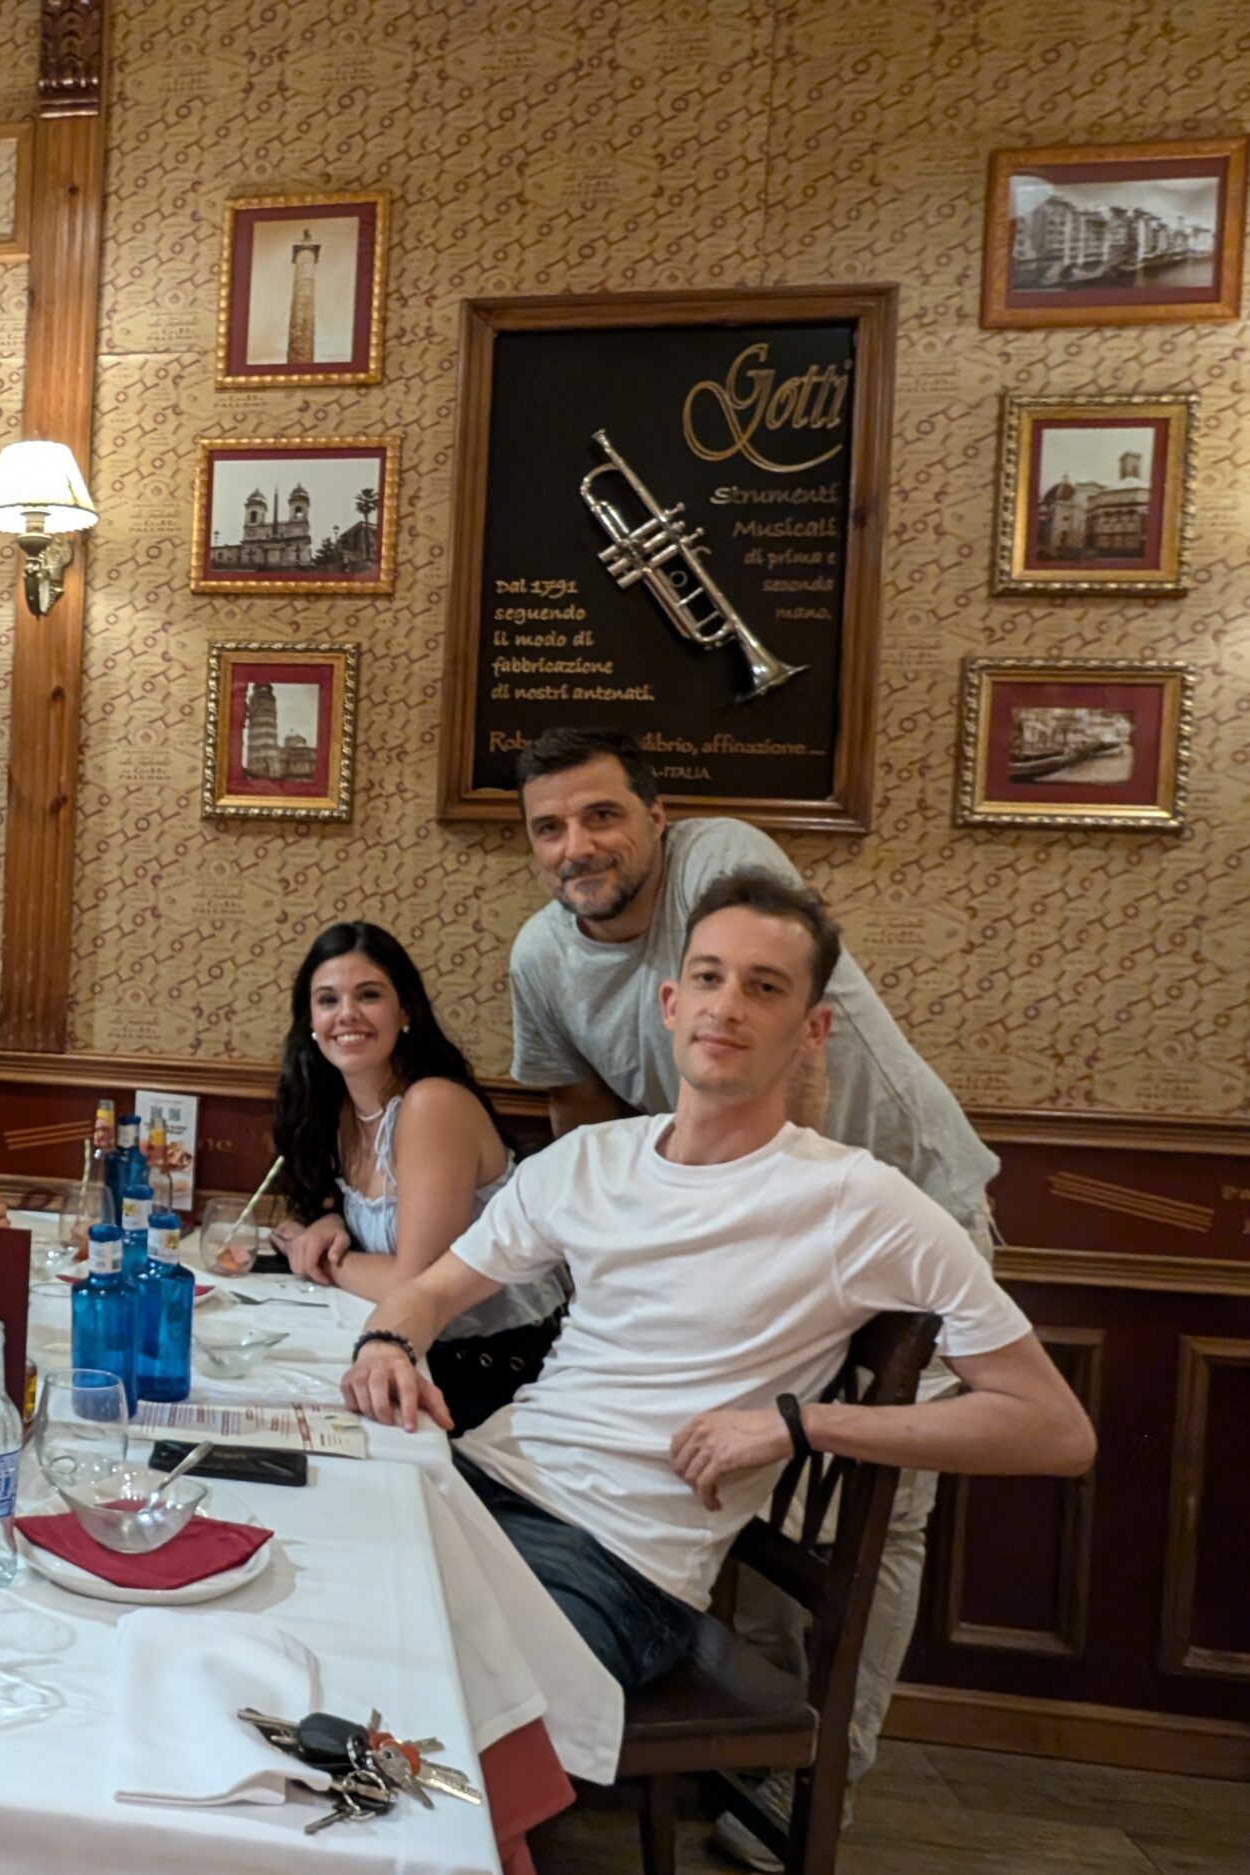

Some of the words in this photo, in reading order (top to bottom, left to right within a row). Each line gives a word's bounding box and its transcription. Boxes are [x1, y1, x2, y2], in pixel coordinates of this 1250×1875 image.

[682, 342, 853, 473] Gotti
[709, 482, 839, 505] Strumenti
[732, 517, 838, 537] Musicali
[495, 578, 528, 594] Dal
[530, 578, 579, 599] 1791
[493, 604, 587, 625] seguendo
[515, 630, 567, 647] modo
[572, 629, 596, 647] di
[491, 655, 614, 678] fabbricazione
[491, 683, 510, 700] di
[514, 683, 569, 700] nostri
